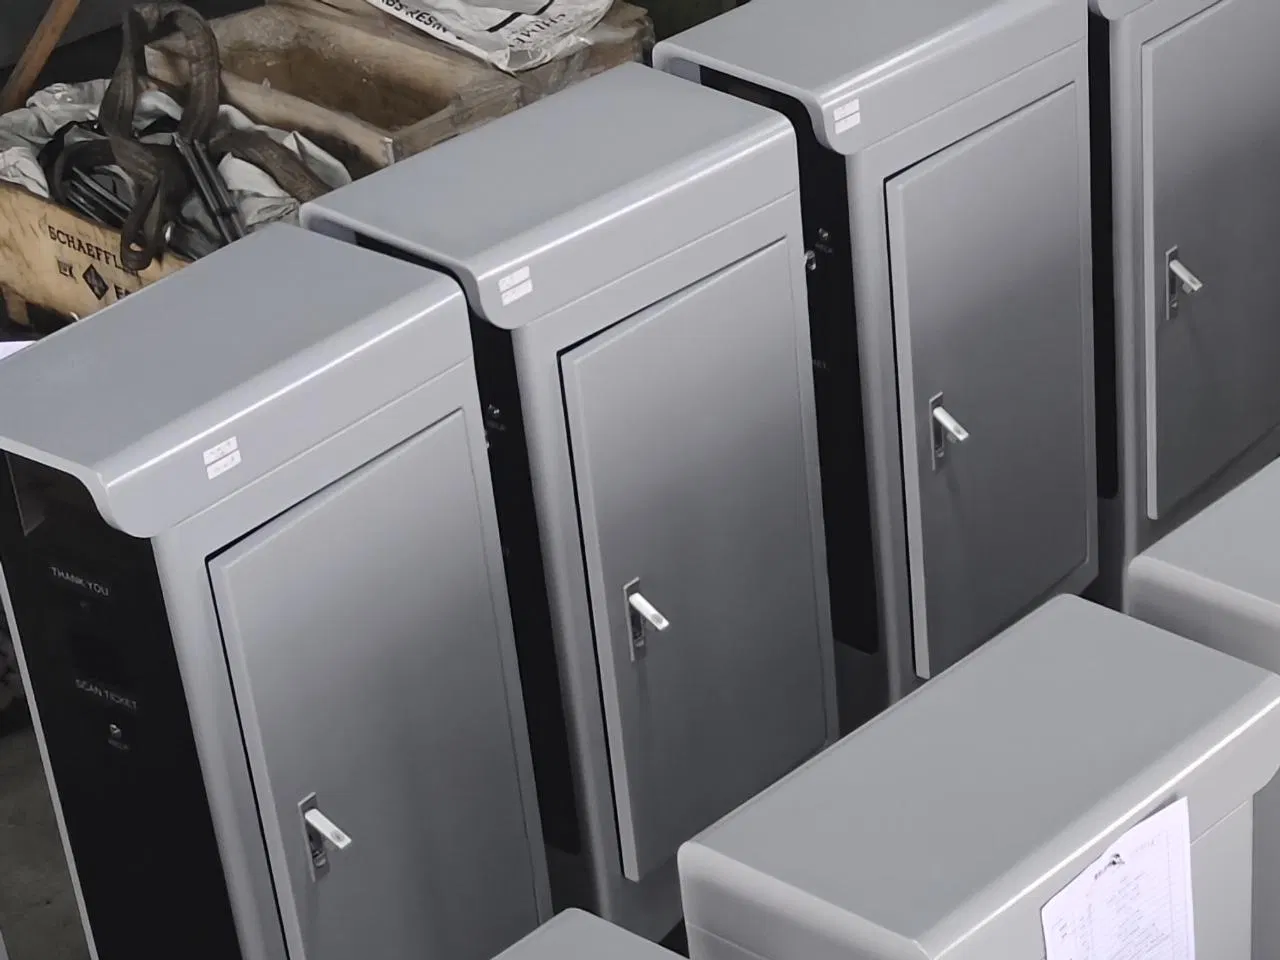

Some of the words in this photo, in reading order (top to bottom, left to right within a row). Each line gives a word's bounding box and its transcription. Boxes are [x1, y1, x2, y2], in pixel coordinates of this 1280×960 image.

[51, 566, 87, 588] THANK
[86, 581, 110, 597] YOU
[75, 679, 102, 697] SCAN
